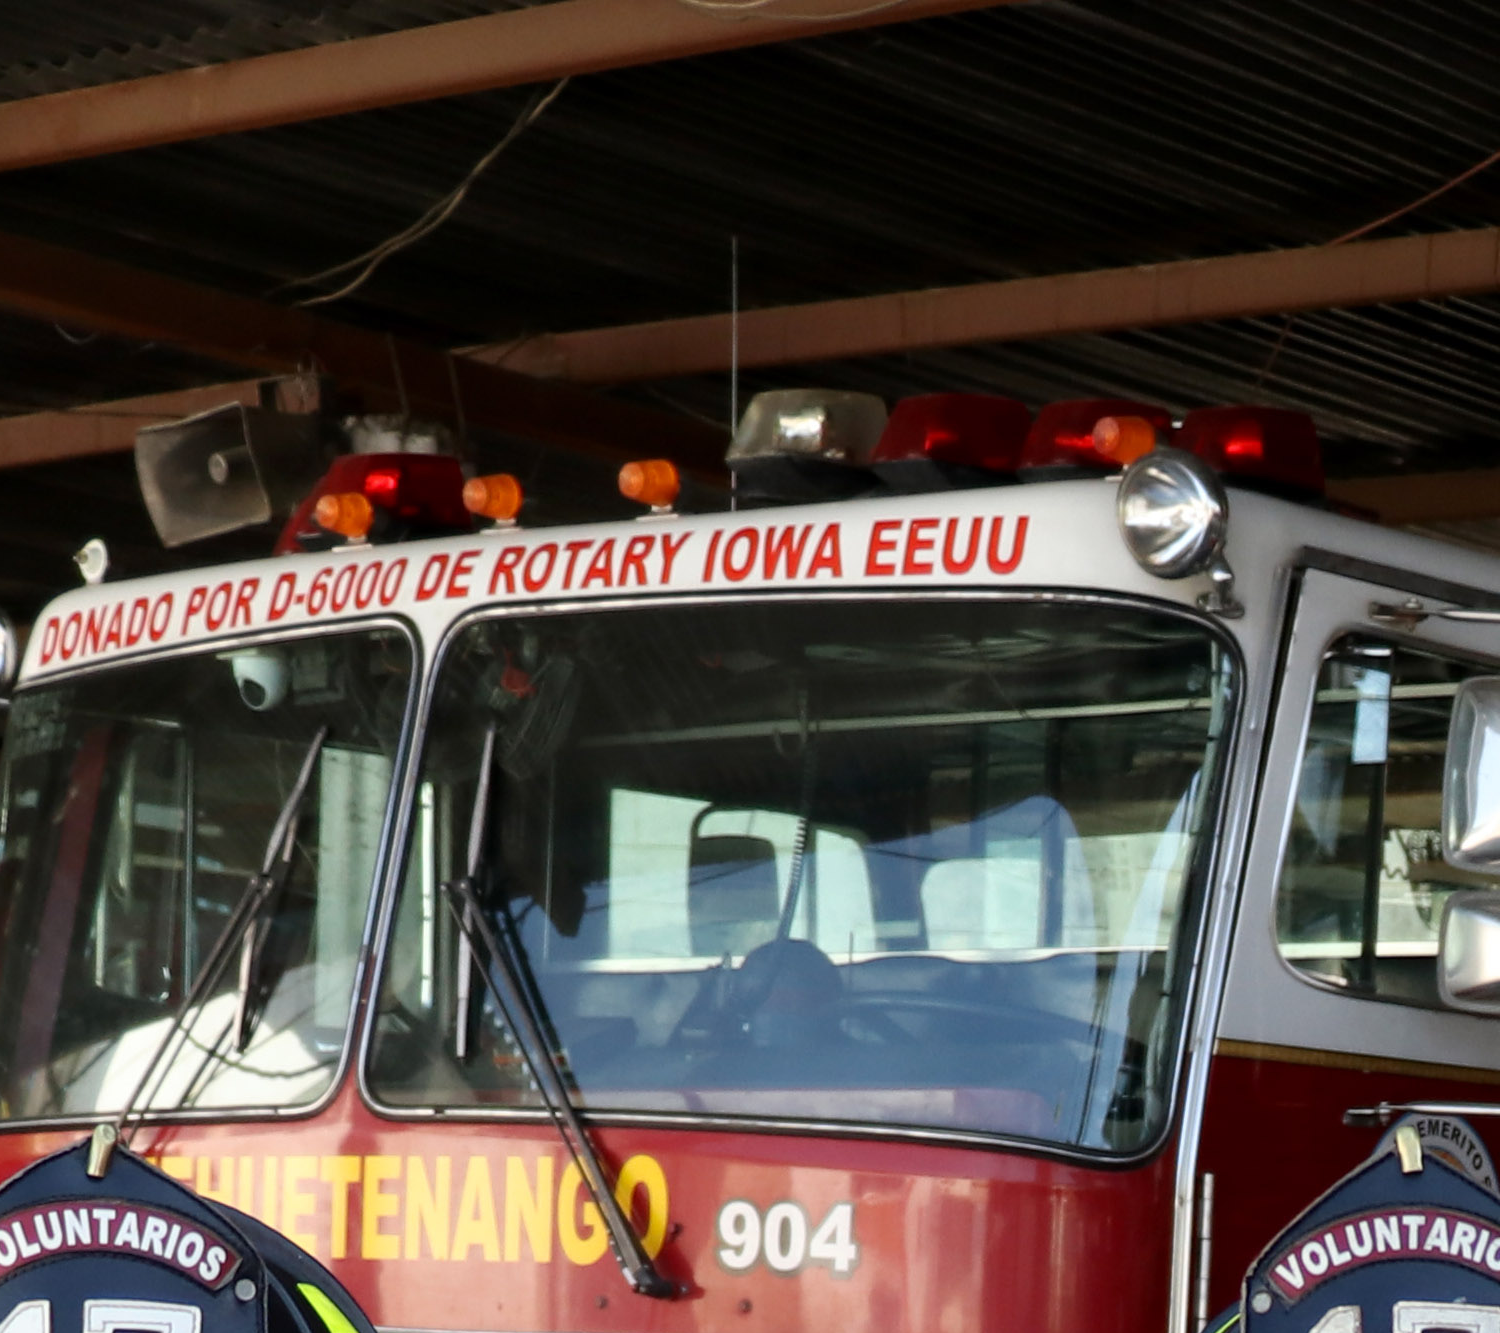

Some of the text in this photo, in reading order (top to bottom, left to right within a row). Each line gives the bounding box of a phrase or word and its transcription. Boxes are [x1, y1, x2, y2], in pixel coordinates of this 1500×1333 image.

[40, 515, 1030, 667] DONADO POR D-6000 DE ROTARY IOWA EEUU
[1417, 1119, 1484, 1171] EMERITO
[716, 1199, 860, 1278] 904
